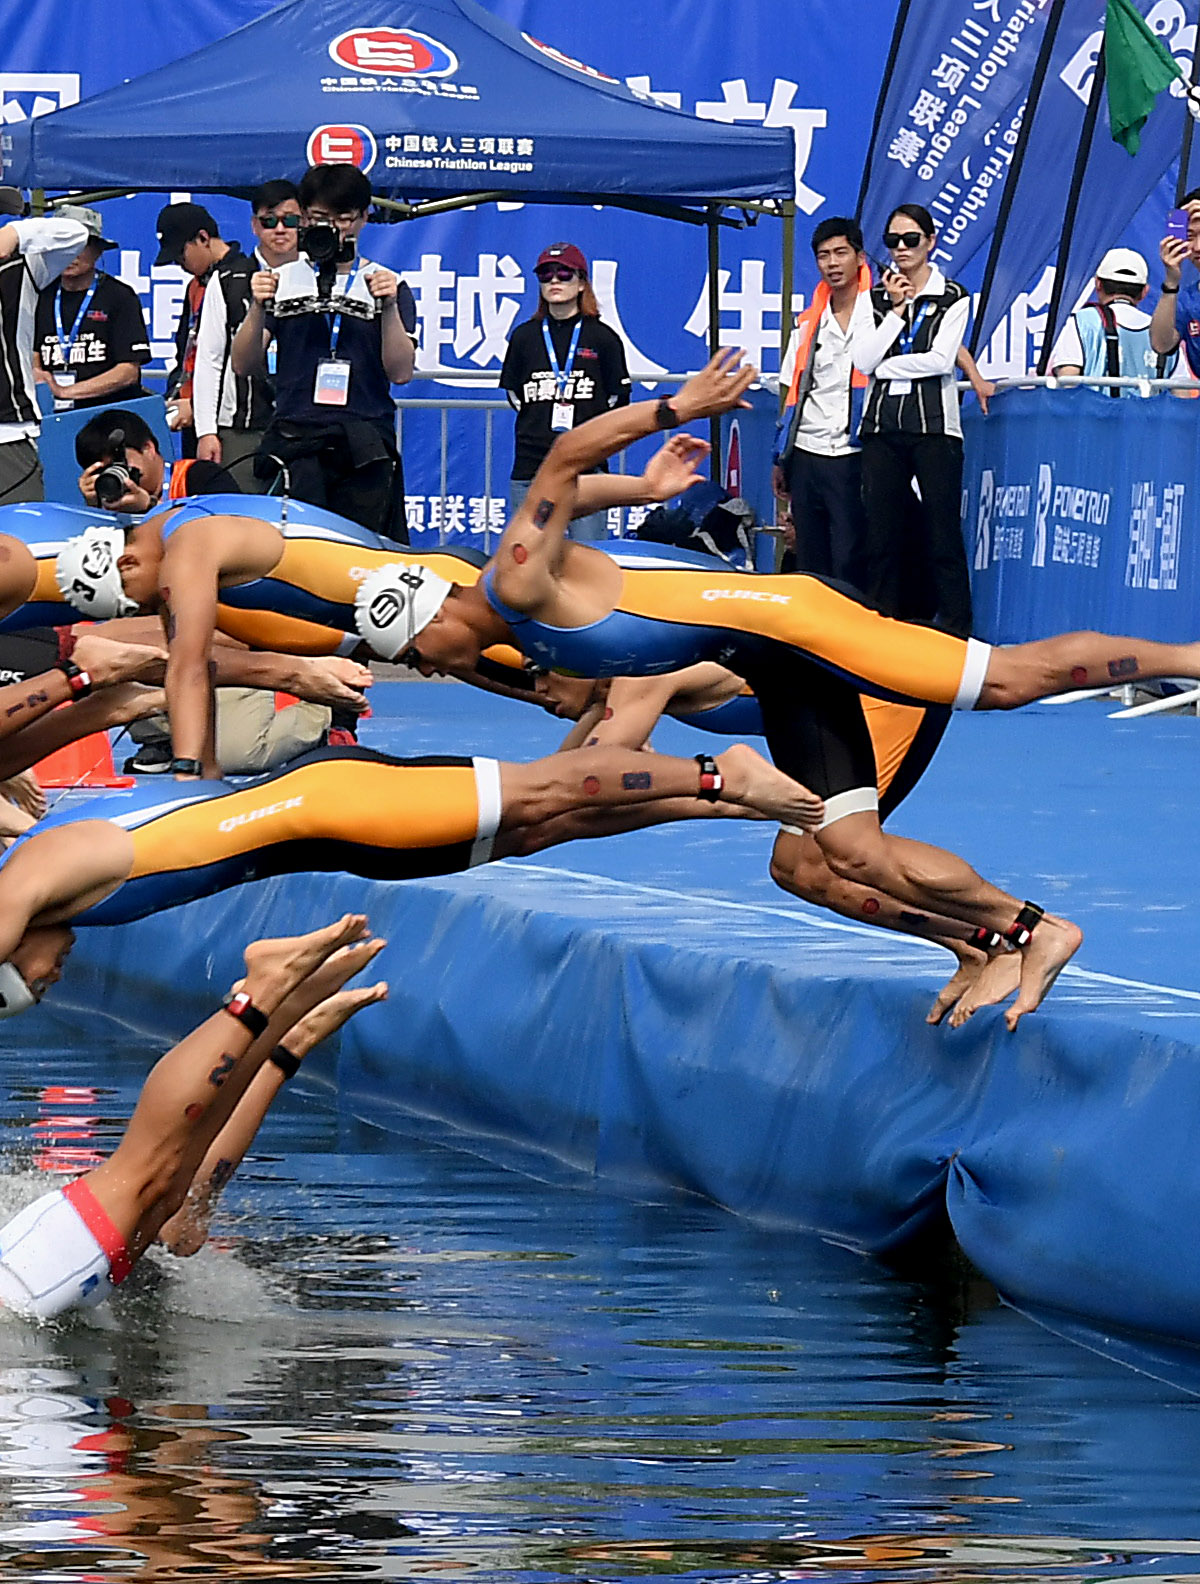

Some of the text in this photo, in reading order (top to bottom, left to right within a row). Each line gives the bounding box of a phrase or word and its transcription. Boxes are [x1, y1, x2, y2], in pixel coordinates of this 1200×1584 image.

[970, 0, 1047, 92] riathlon
[385, 134, 534, 156] 中国铁人三项联赛
[917, 94, 982, 180] League
[489, 159, 534, 174] League
[701, 589, 793, 605] QUICK
[218, 795, 304, 832] QUICK
